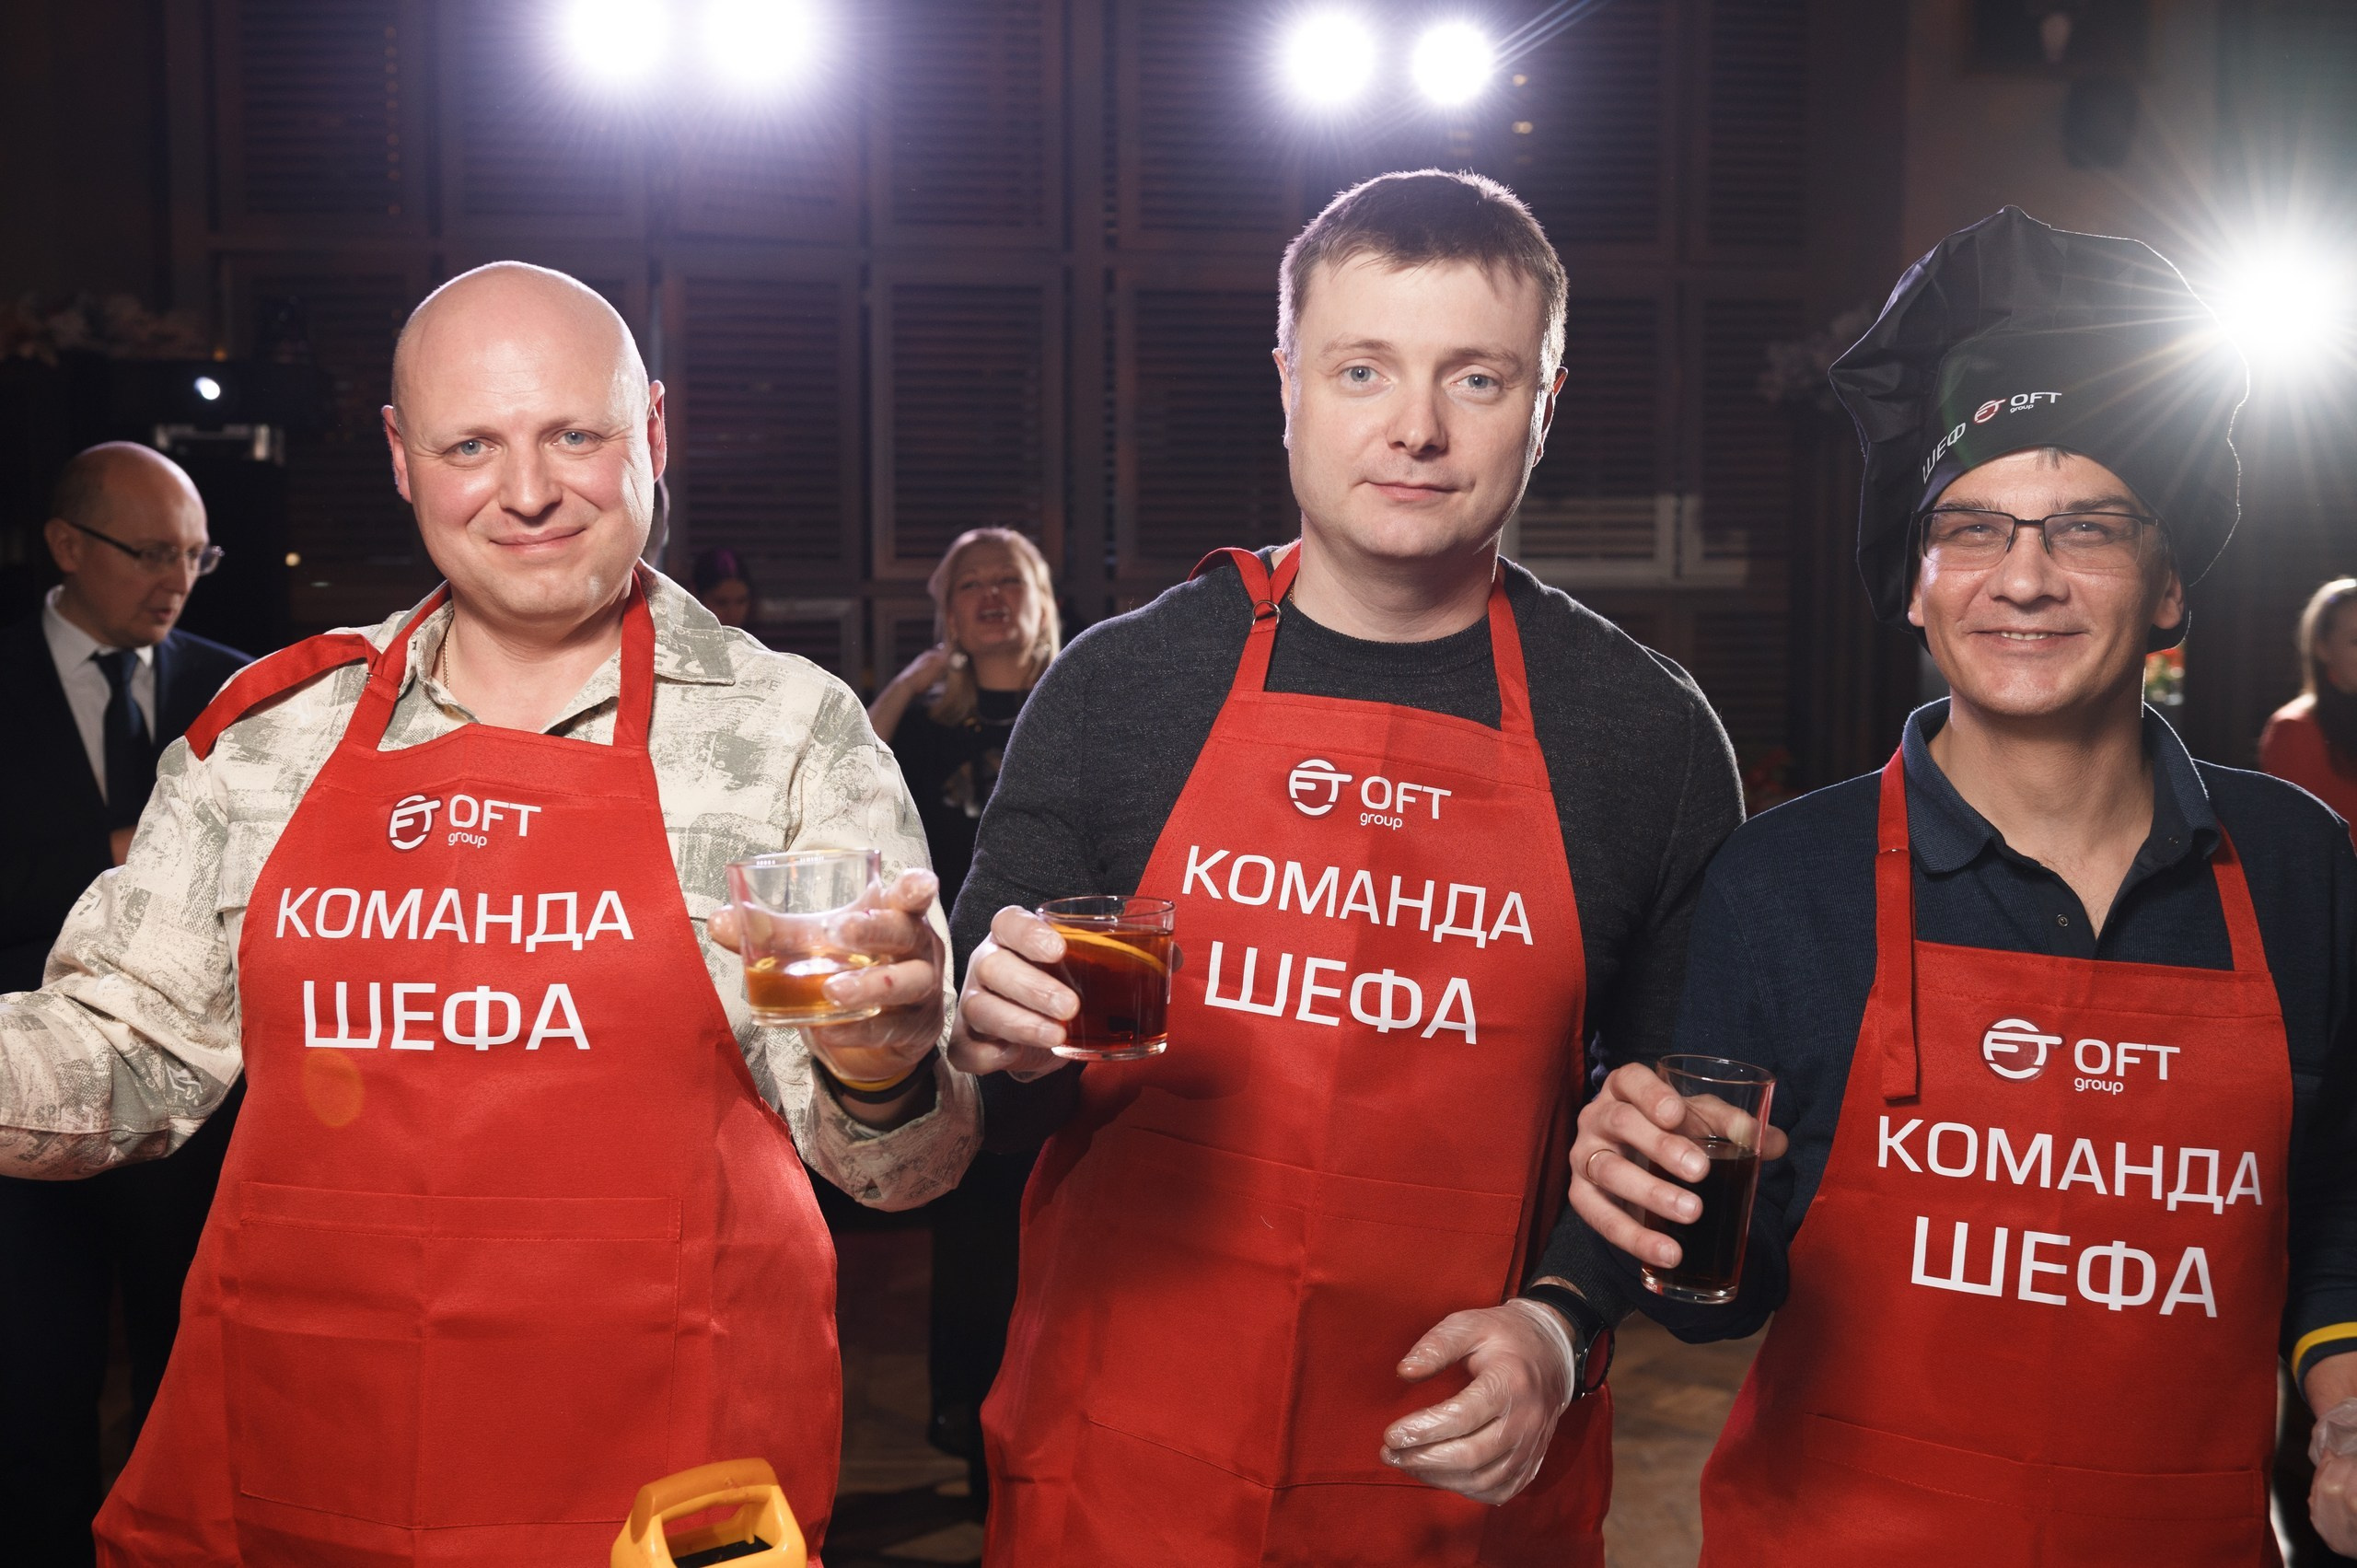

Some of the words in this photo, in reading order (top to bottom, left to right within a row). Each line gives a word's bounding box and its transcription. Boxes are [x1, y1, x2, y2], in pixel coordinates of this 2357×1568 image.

[2009, 403, 2035, 414] group
[2010, 391, 2063, 407] OFT
[1922, 421, 1968, 485] ШЕФ
[448, 794, 542, 838] OFT
[1360, 775, 1452, 820] OFT
[447, 831, 488, 849] group
[1359, 812, 1403, 830] group
[1181, 844, 1534, 949] КОМАНДА
[275, 887, 634, 953] КОМАНДА
[1203, 940, 1477, 1045] ШЕФА
[303, 980, 591, 1051] ШЕФА
[2073, 1038, 2181, 1081] OFT
[2073, 1077, 2124, 1096] group
[1877, 1115, 2262, 1215] КОМАНДА
[1910, 1215, 2218, 1318] ШЕФА
